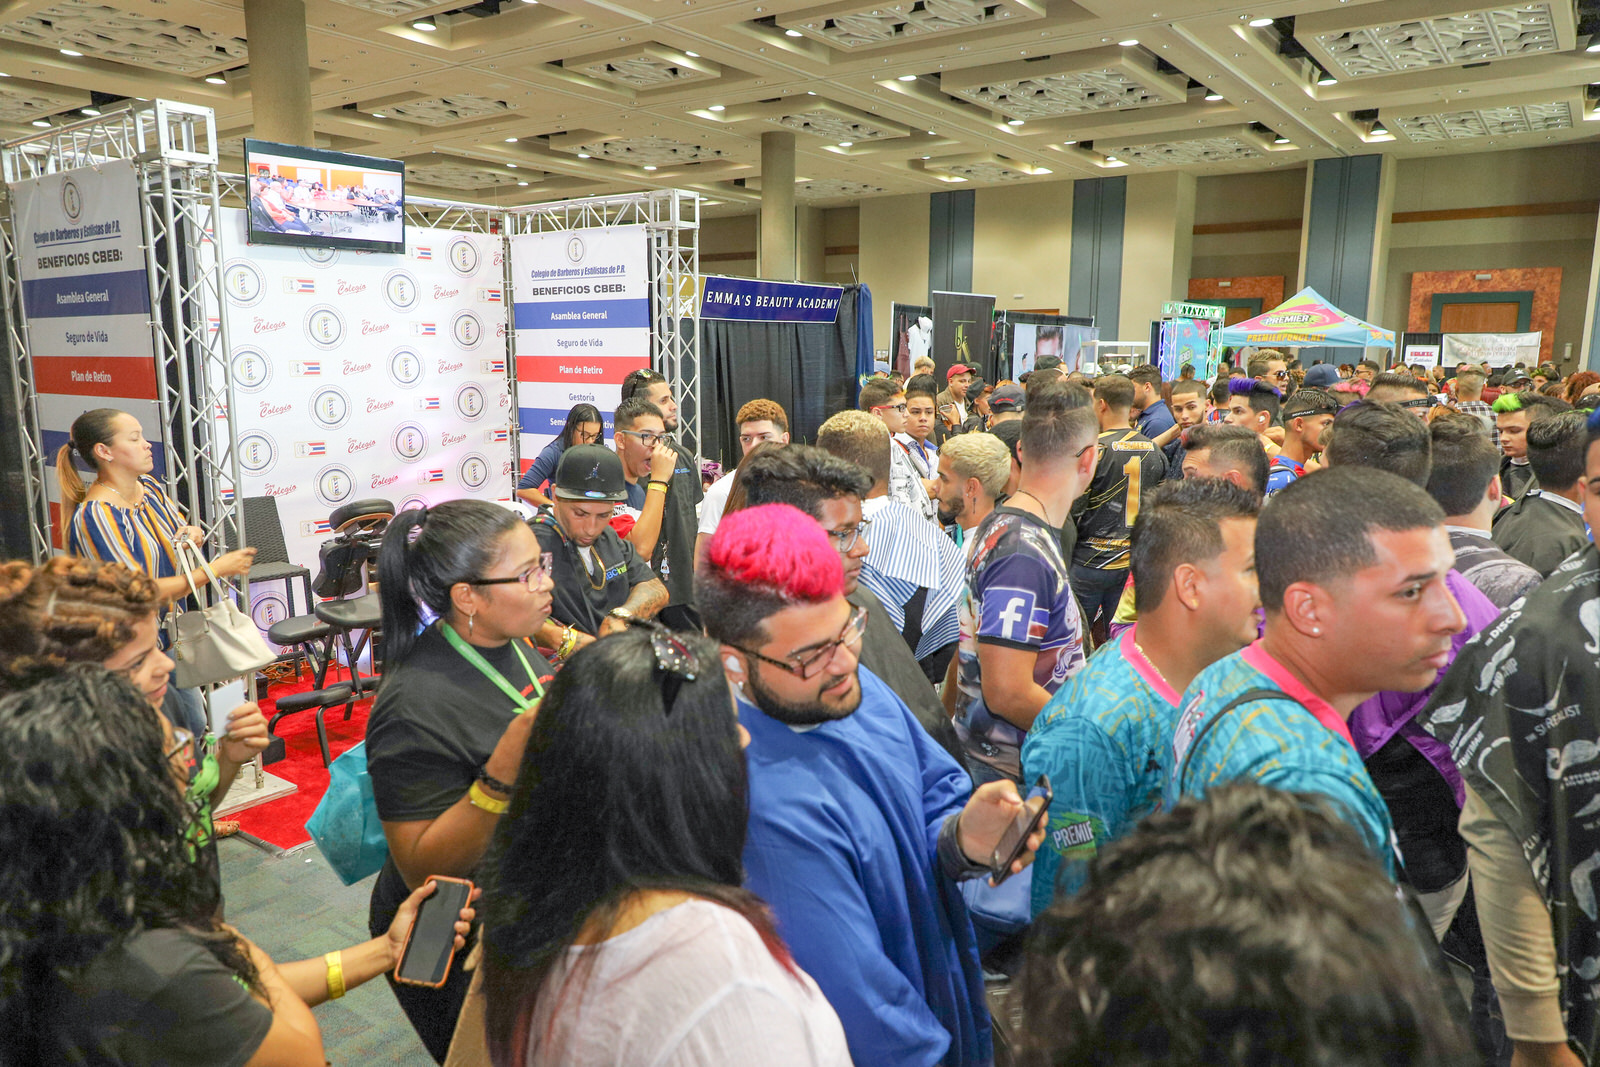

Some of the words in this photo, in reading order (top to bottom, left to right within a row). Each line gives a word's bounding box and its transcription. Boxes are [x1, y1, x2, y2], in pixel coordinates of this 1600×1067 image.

[50, 230, 55, 242] de
[56, 228, 79, 240] Barberos
[84, 224, 104, 237] Estilistas
[105, 222, 111, 234] de
[38, 252, 89, 269] BENEFICIOS
[92, 248, 122, 264] CBEB:
[531, 270, 550, 278] Colegio
[550, 269, 556, 277] de
[557, 268, 580, 277] Barberos
[585, 266, 608, 275] Estilistas
[609, 265, 616, 273] de
[338, 284, 366, 295] Colegio
[434, 288, 459, 299] Colegio
[532, 285, 590, 296] BENEFICIOS
[594, 284, 626, 293] CBEB:
[56, 292, 84, 304] Asamblea
[85, 290, 109, 302] General
[706, 291, 751, 306] EMMA'S
[756, 296, 794, 308] BEAUTY
[796, 298, 838, 309] ACADEMY
[550, 312, 581, 320] Asamblea
[582, 310, 607, 319] General
[1265, 314, 1310, 325] PREMIER
[254, 321, 286, 334] Colegio
[362, 324, 390, 335] Colegio
[66, 332, 85, 346] Seguro
[86, 331, 94, 342] de
[94, 331, 108, 342] Vida
[557, 339, 578, 348] Seguro
[580, 339, 588, 347] de
[588, 339, 603, 347] Vida
[342, 363, 371, 376] Colegio
[438, 362, 463, 374] Colegio
[559, 366, 573, 374] Plan
[574, 366, 582, 374] de
[583, 366, 603, 374] Retiro
[71, 370, 84, 382] Plan
[85, 370, 92, 382] de
[93, 371, 112, 383] Retiro
[568, 393, 595, 401] Gestoría
[260, 404, 292, 418] Colegio
[366, 400, 394, 413] Colegio
[348, 440, 376, 453] Colegio
[442, 434, 467, 446] Colegio
[371, 475, 398, 489] Colegio
[265, 485, 297, 497] Colegio
[1123, 456, 1141, 528] 1
[1489, 611, 1522, 639] DISCO
